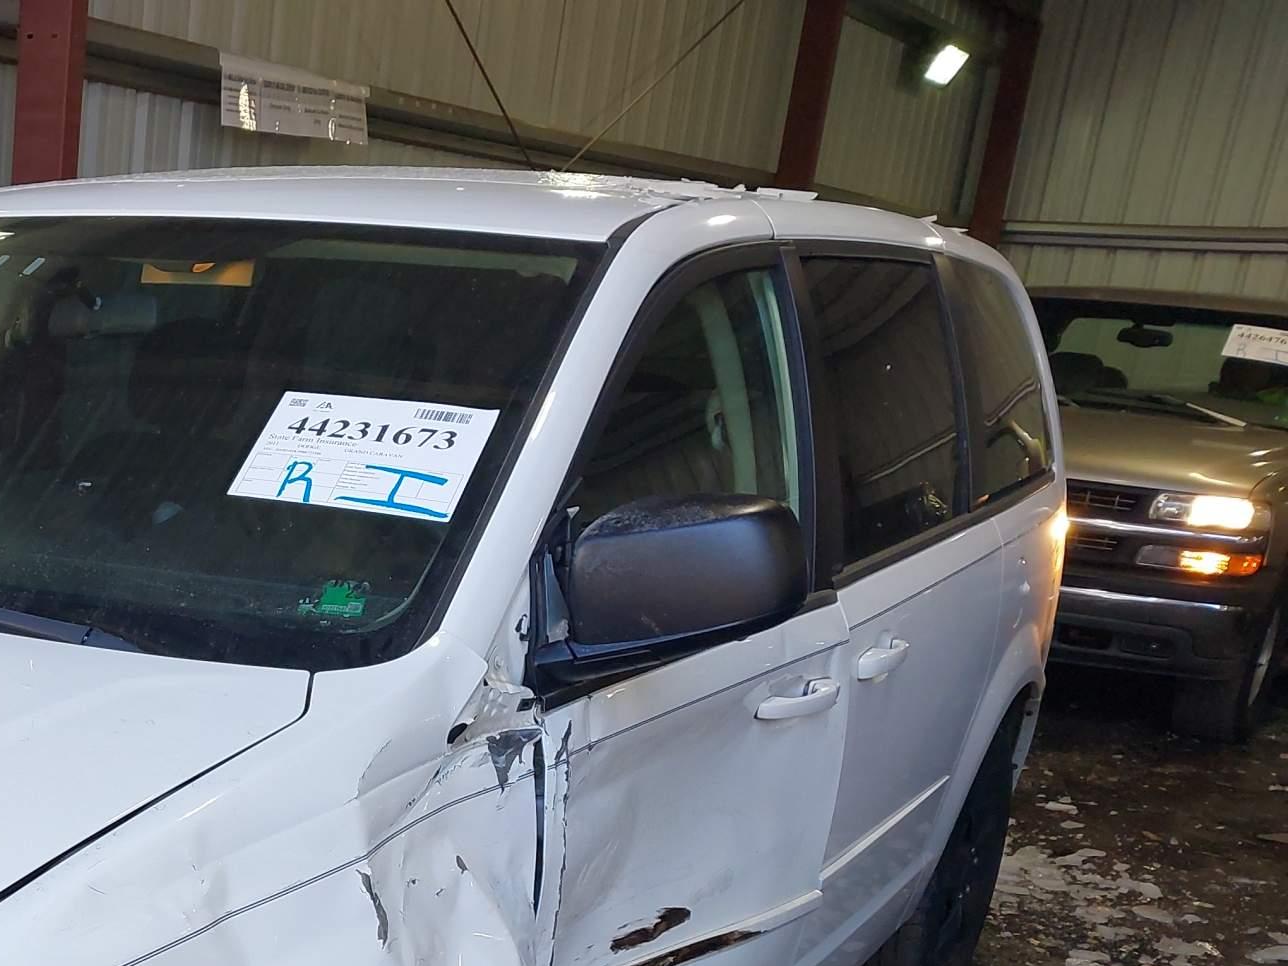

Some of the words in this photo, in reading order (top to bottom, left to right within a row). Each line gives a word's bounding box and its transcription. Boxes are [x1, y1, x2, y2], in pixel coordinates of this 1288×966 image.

[269, 433, 289, 441] State
[292, 435, 314, 443] Farm
[316, 437, 358, 447] Insurance
[288, 416, 458, 450] 44231673
[276, 460, 313, 503] R
